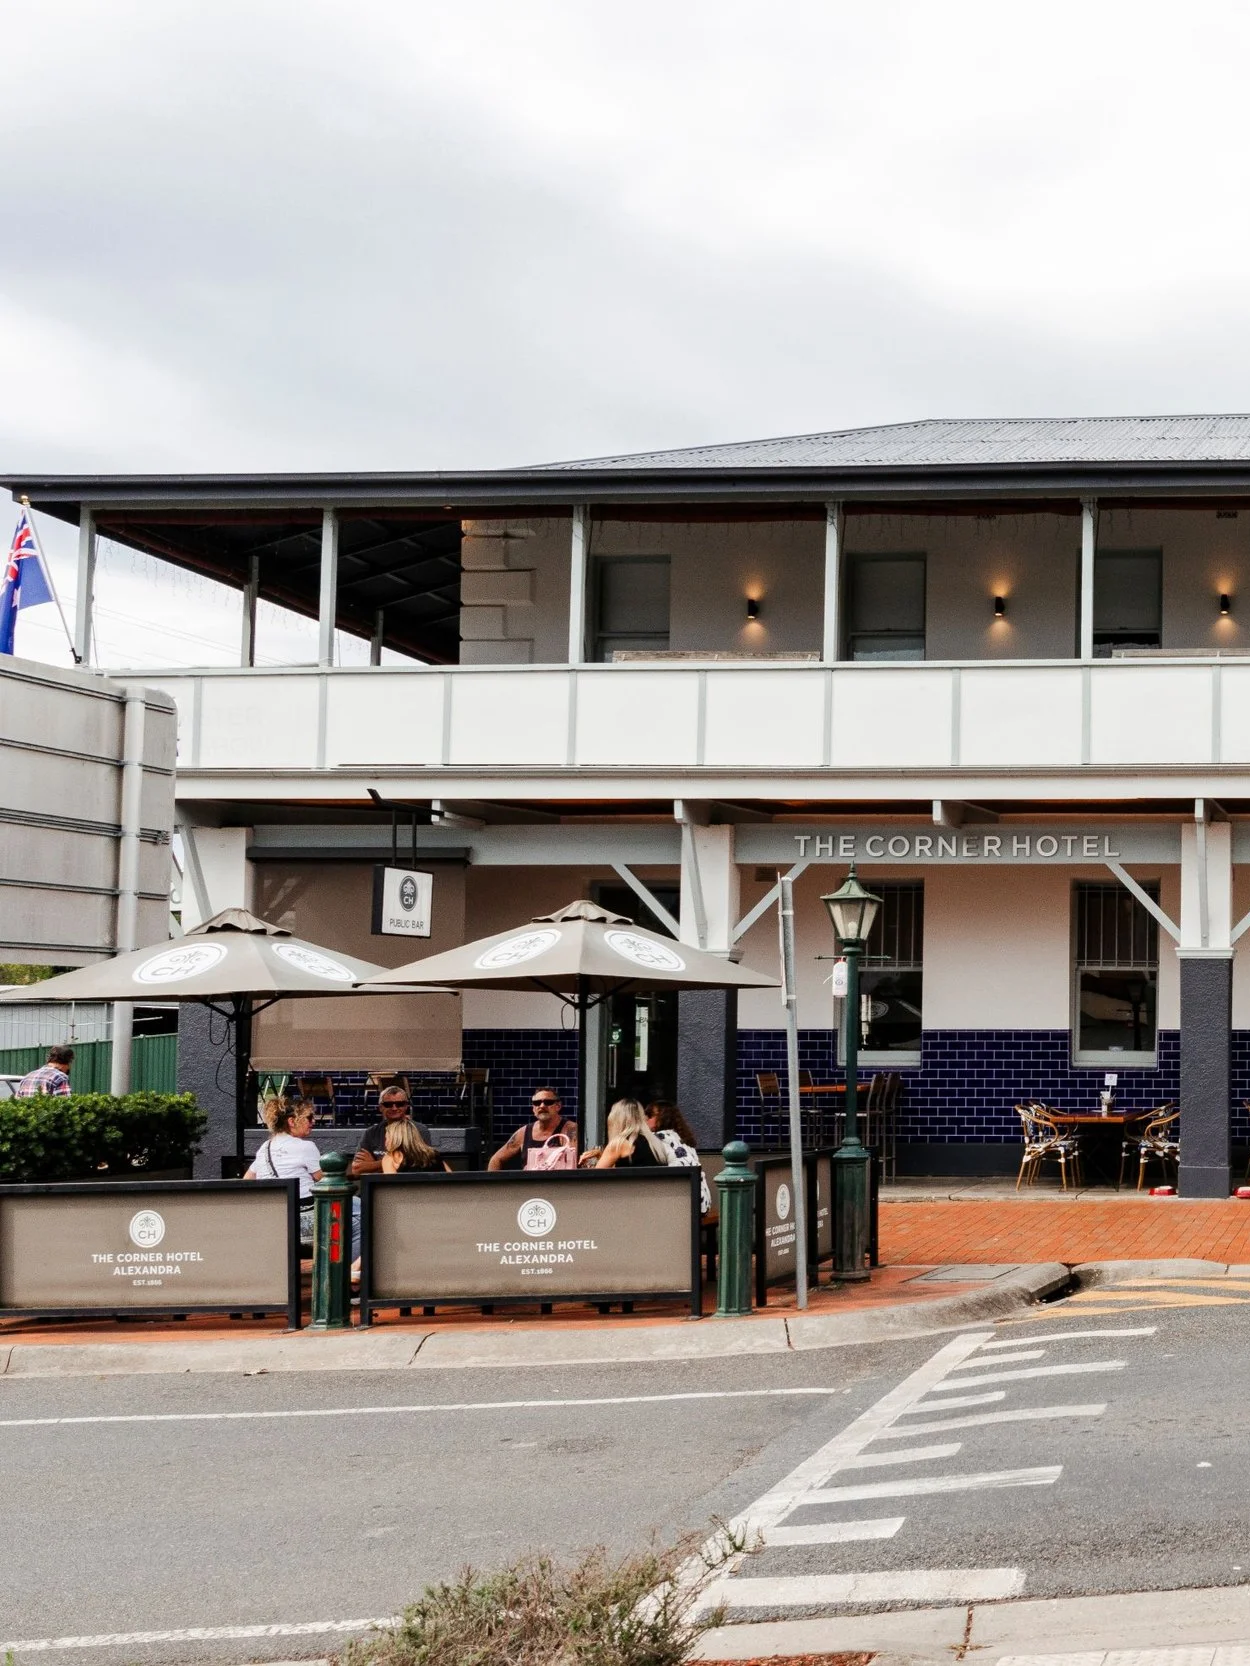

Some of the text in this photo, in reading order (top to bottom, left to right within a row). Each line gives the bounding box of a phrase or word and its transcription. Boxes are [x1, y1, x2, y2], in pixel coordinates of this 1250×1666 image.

[794, 835, 1121, 857] THE CORNER HOTEL
[403, 896, 414, 905] CH
[390, 918, 424, 929] PUBLIC BAR
[151, 965, 196, 976] CH
[527, 1219, 547, 1228] CH
[138, 1230, 157, 1240] CH
[476, 1240, 598, 1253] THE CORNER HOTEL
[91, 1251, 204, 1263] THE CORNER HOTEL
[500, 1253, 574, 1265] ALEXANDRA
[113, 1265, 181, 1276] ALEXANDRA
